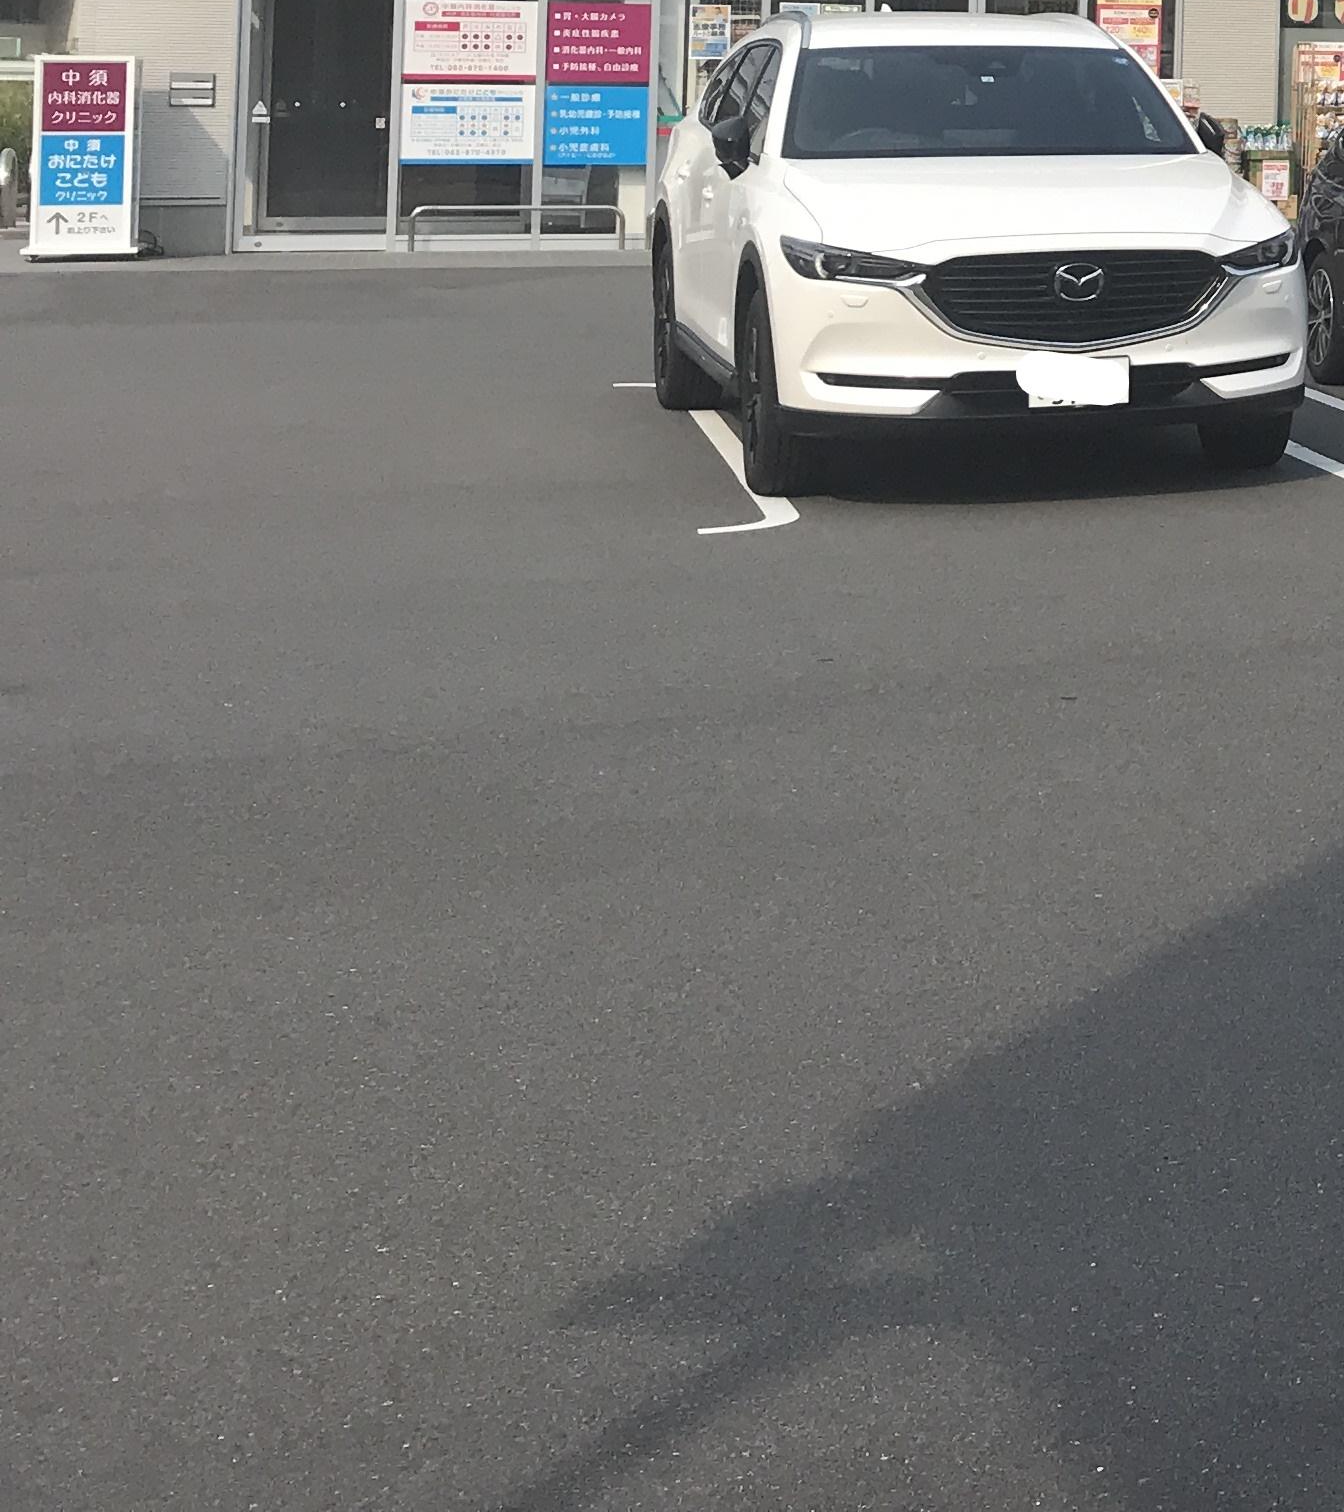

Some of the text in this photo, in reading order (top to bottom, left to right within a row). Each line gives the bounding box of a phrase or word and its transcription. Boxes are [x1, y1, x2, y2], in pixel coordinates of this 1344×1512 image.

[61, 69, 108, 87] 中須
[48, 91, 121, 105] 内科消化器
[51, 110, 118, 124] クリニック
[64, 139, 102, 152] 中須
[48, 154, 117, 169] おにたけ
[55, 172, 108, 188] こども
[55, 190, 108, 202] クリニック
